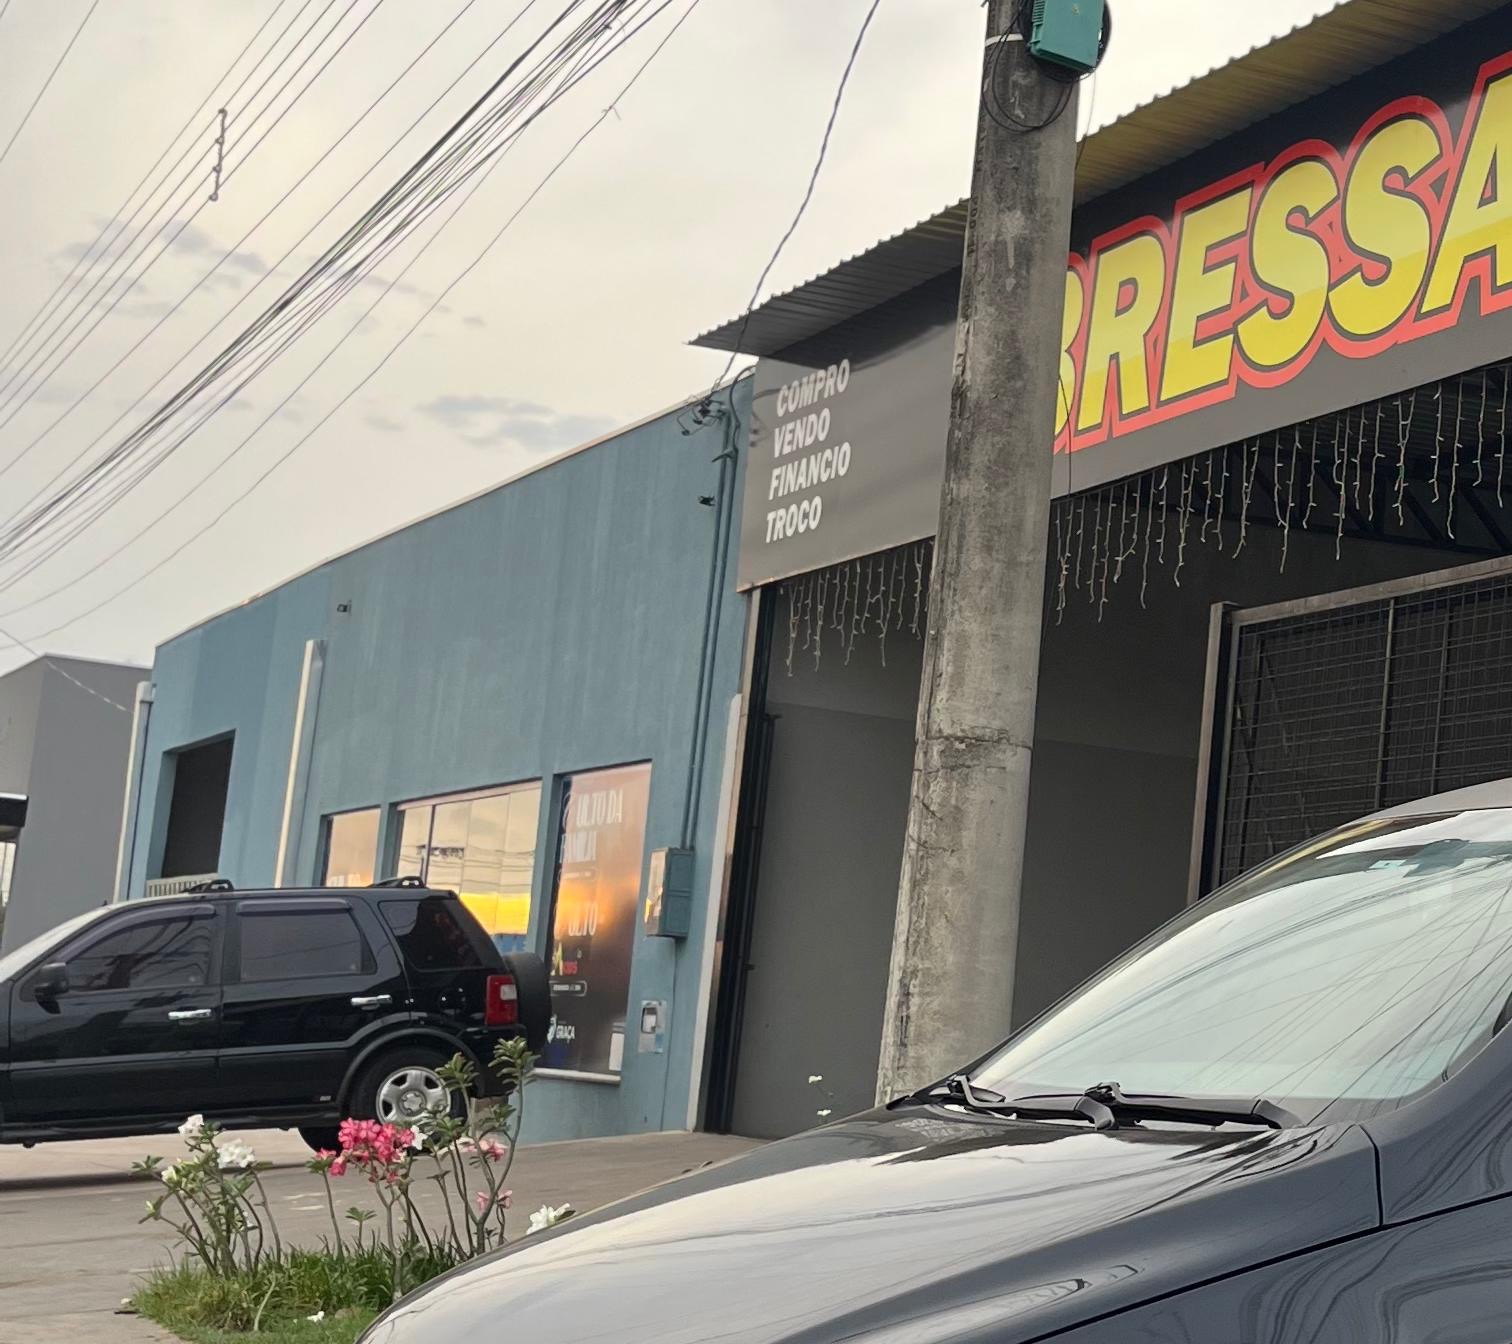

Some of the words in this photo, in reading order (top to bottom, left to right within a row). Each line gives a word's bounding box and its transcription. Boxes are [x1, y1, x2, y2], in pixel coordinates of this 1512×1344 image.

[777, 358, 850, 417] COMPRO
[774, 407, 831, 458] VENDO
[768, 441, 851, 501] FINANCIO
[765, 495, 822, 544] TROCO
